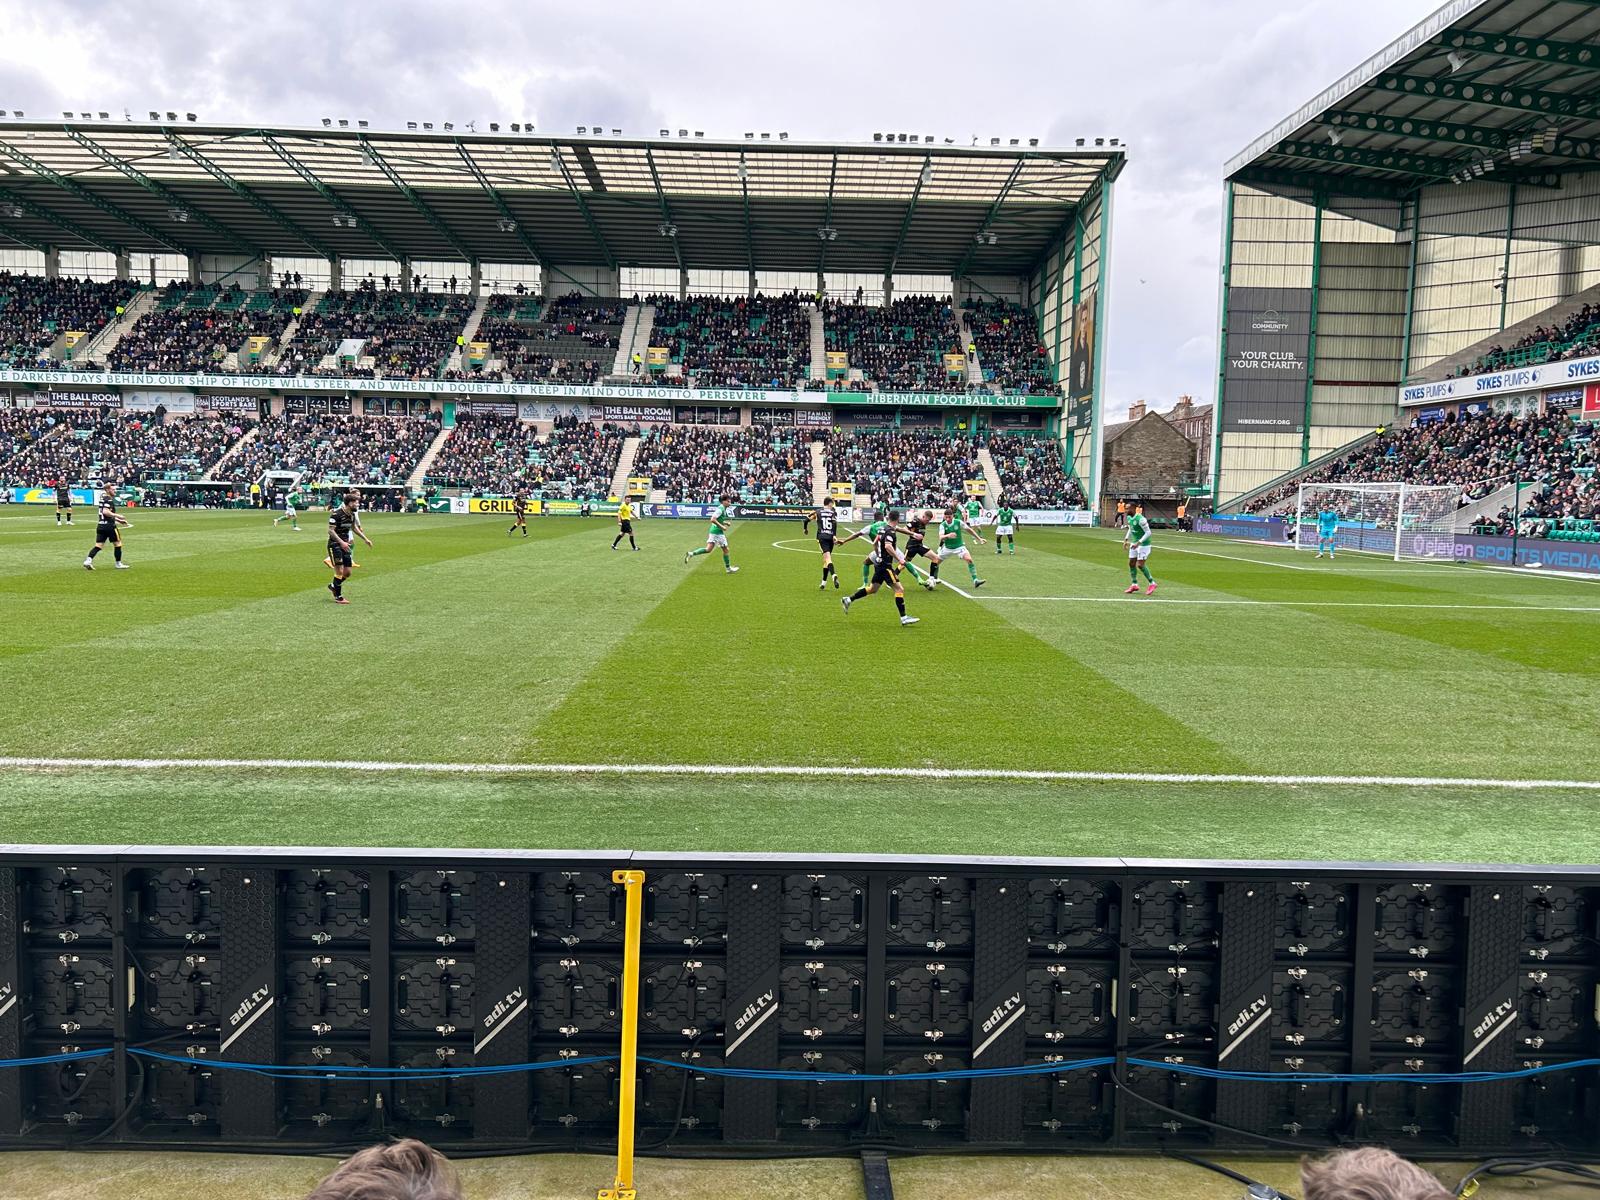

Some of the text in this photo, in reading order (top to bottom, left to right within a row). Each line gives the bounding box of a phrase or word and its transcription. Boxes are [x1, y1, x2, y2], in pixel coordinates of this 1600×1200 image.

[1232, 360, 1304, 370] YOUR CHARITY.
[1241, 352, 1296, 360] YOUR CLUB.
[1568, 360, 1600, 378] SYKES
[12, 372, 66, 382] DARKEST
[72, 374, 102, 382] DAYS
[160, 376, 188, 384] OUR
[190, 376, 217, 386] SHIP
[222, 378, 238, 386] OF
[243, 378, 275, 387] HOPE
[280, 379, 310, 388] WILL
[360, 381, 384, 390] AND
[390, 382, 426, 391] WHEN
[432, 383, 442, 392] IN
[450, 384, 490, 392] DOUBT
[496, 384, 526, 394] JUST
[530, 386, 558, 394] KEEP
[564, 386, 576, 395] IN
[582, 387, 614, 396] MIND
[618, 388, 643, 397] OUR
[700, 390, 767, 400] PERSEVERE
[1476, 371, 1530, 390] SYKES PUMPS
[52, 392, 69, 400] THE
[70, 393, 90, 401] BALL
[92, 394, 120, 402] ROOM
[866, 393, 1026, 406] HIBERNIAN FOOTBALL CLUB
[1404, 384, 1446, 400] SYKES PUMPS
[623, 407, 643, 415] BALL
[644, 408, 672, 416] ROOM
[822, 518, 833, 530] 16
[1202, 522, 1270, 538] eleven SPORTS MEDIA
[1544, 550, 1600, 568] MEDIA
[230, 984, 270, 1026] adi.tv
[484, 986, 524, 1028] adi.tv
[734, 988, 774, 1031] adi.tv
[982, 992, 1022, 1033] adi.tv
[1226, 994, 1268, 1036] adi.tv
[1472, 998, 1513, 1039] adi.tv
